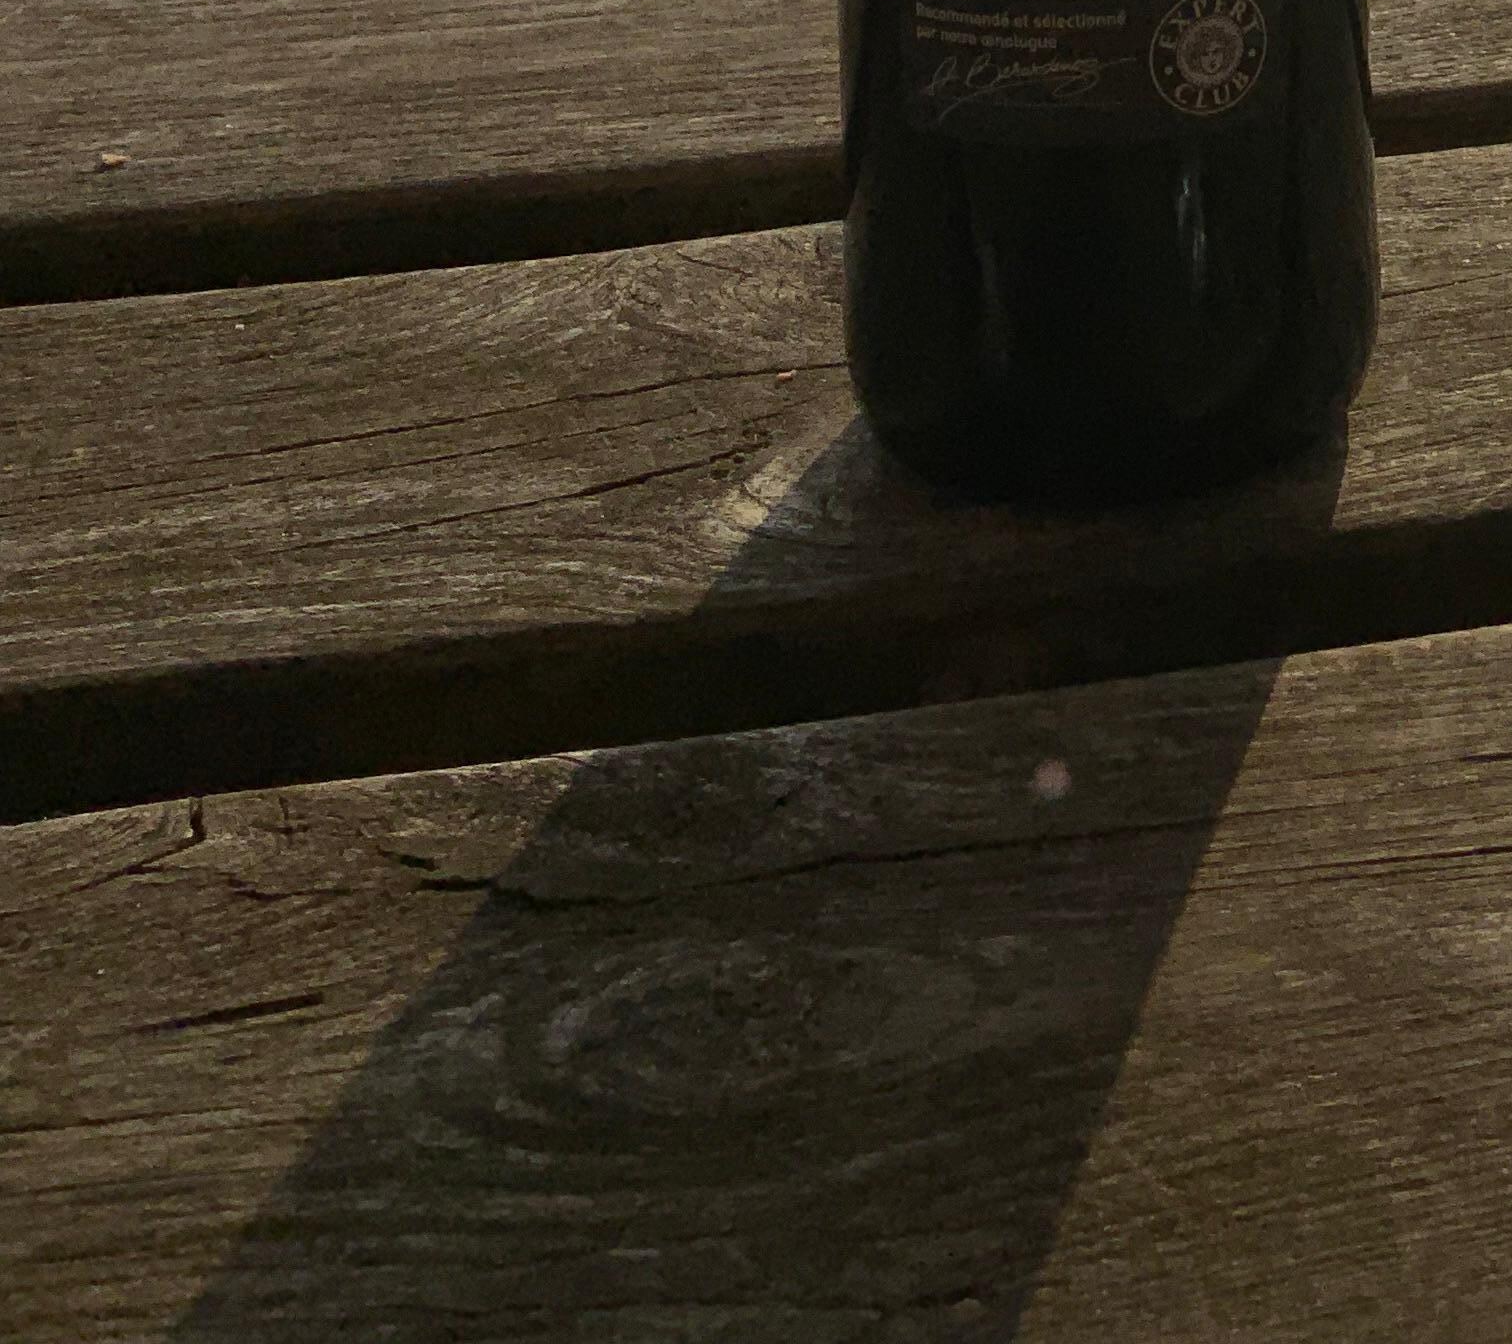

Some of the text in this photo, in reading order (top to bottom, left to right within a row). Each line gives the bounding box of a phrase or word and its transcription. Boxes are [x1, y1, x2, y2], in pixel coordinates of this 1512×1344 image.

[915, 1, 1127, 29] Recommandé et sélectionné
[1174, 71, 1250, 109] CLUB
